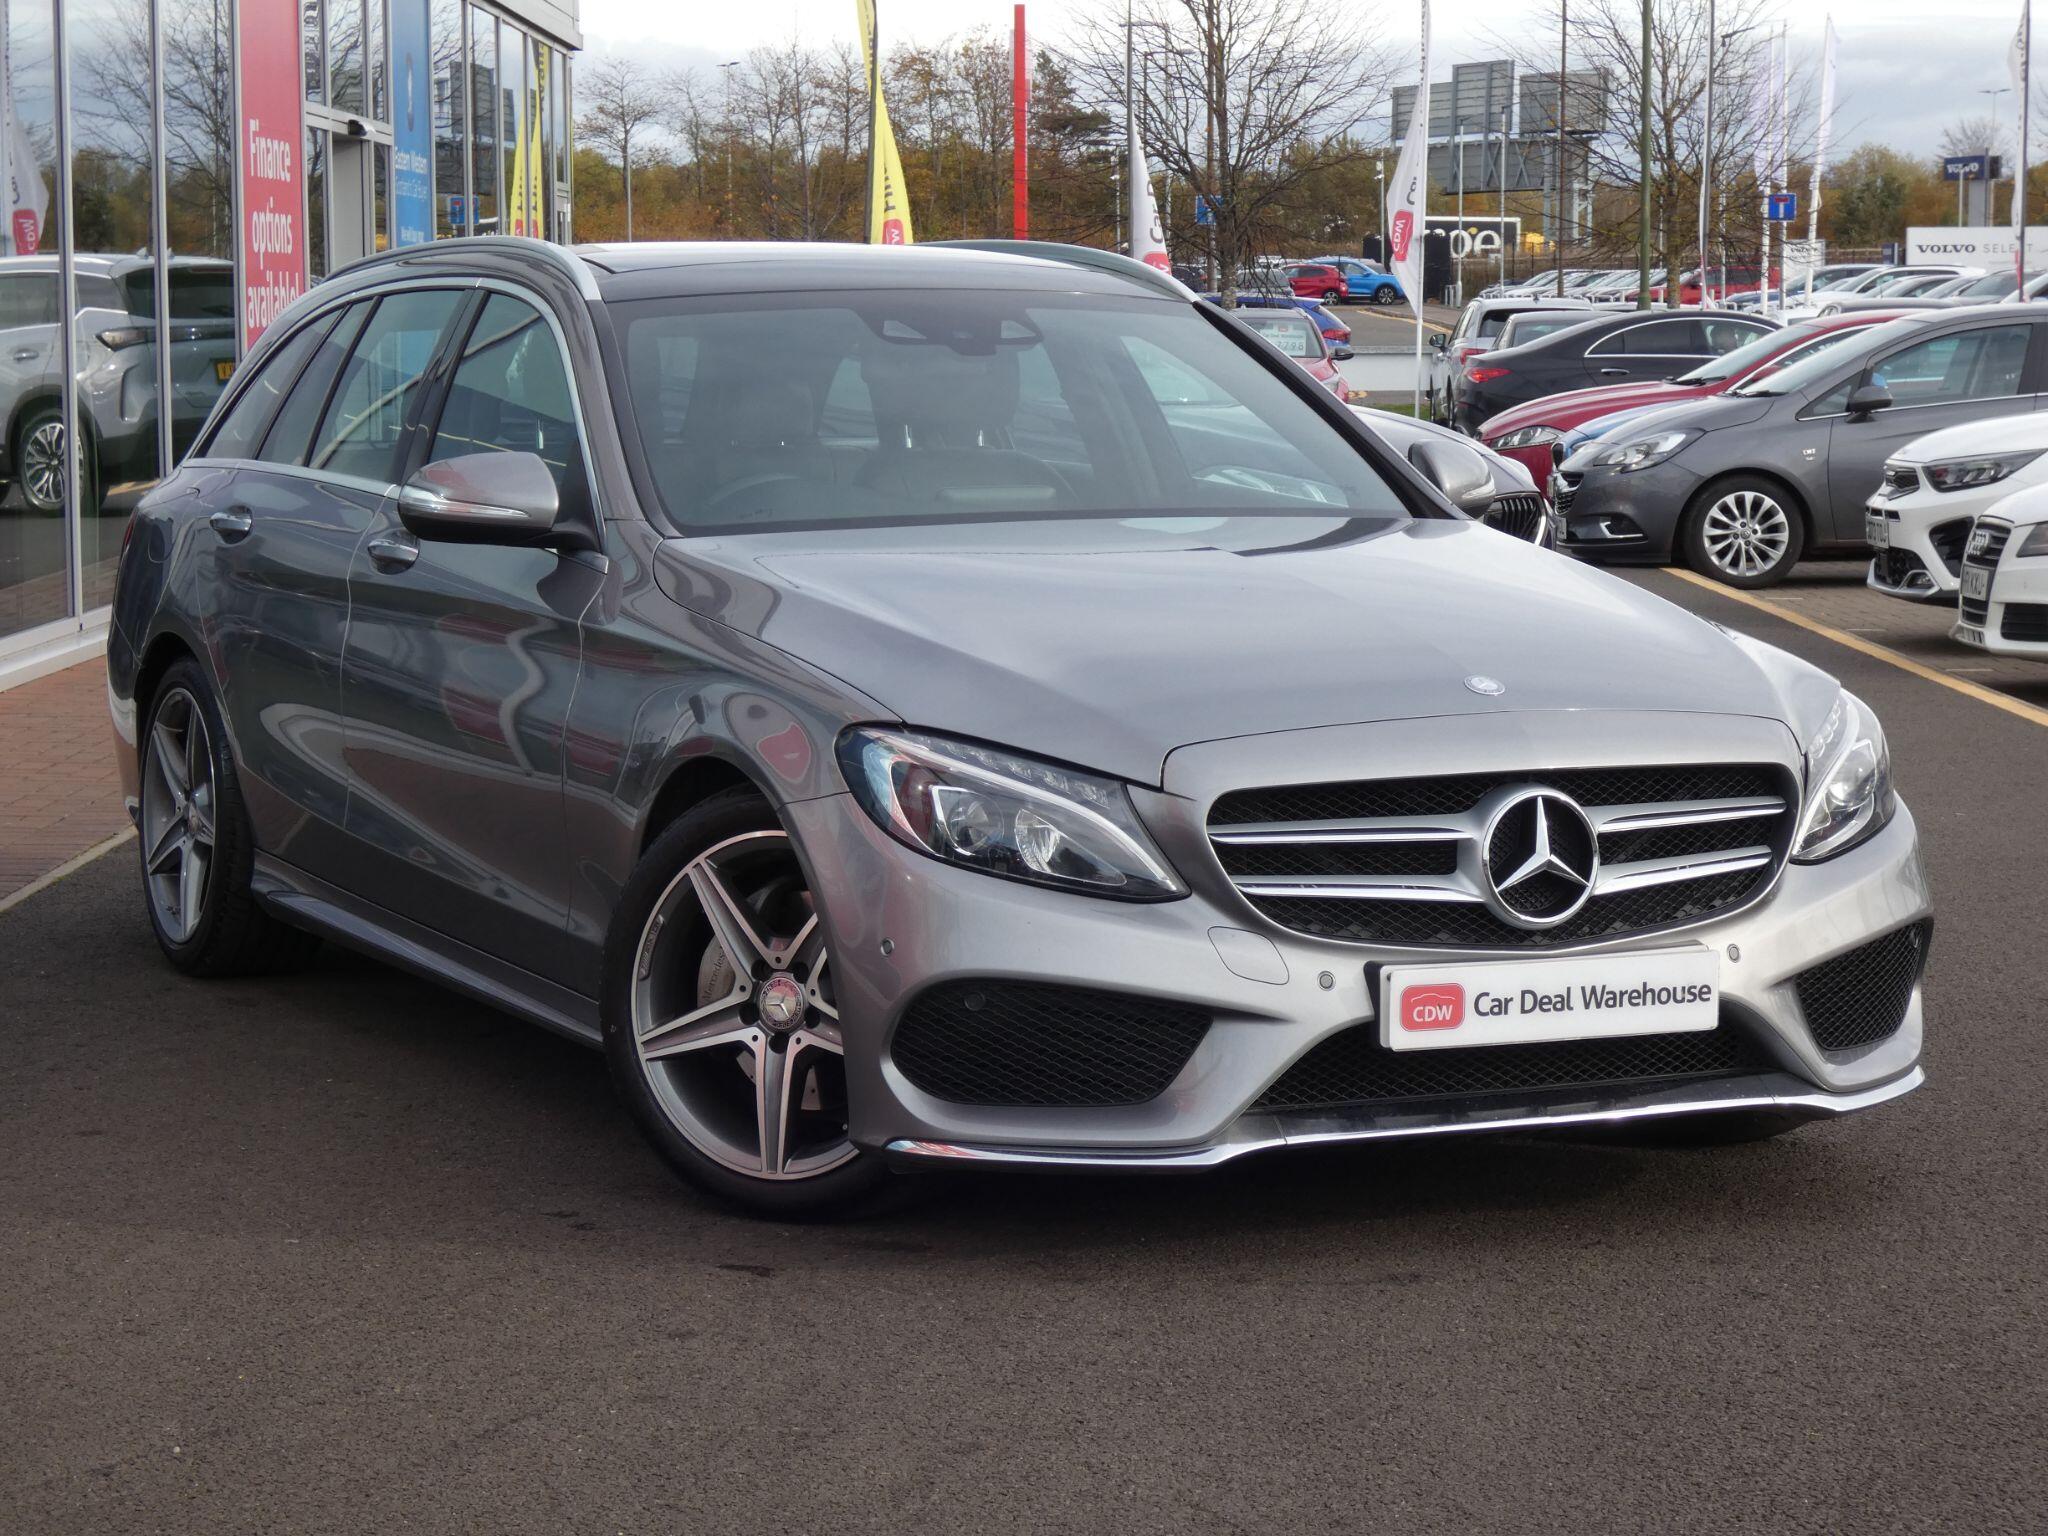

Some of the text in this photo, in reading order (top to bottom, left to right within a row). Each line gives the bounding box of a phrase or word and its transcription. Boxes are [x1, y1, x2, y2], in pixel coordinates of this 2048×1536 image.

[250, 119, 291, 182] Finance
[252, 197, 292, 269] options
[1917, 243, 2033, 254] VOLVO SELET
[1412, 1004, 1453, 1024] CDW
[1473, 981, 1712, 1017] Car Deal Warehouse
